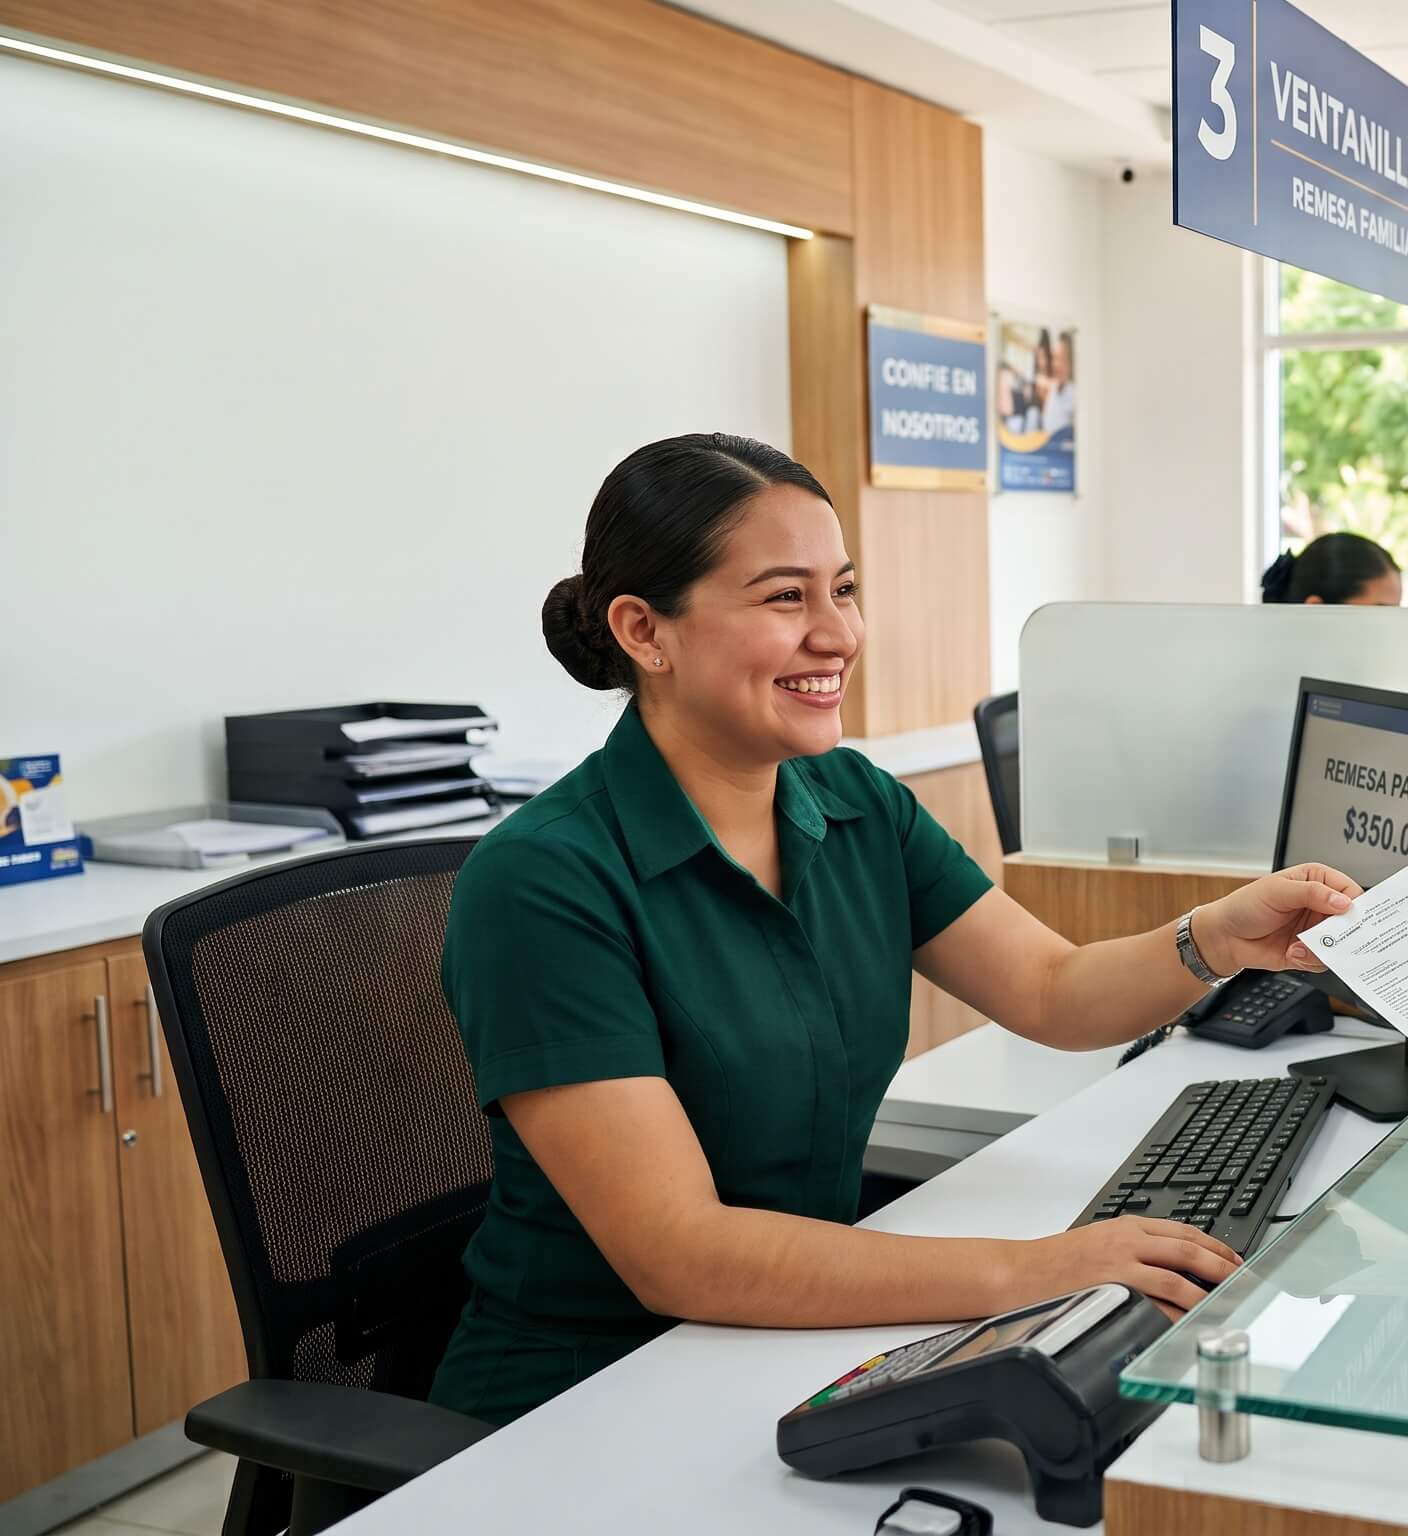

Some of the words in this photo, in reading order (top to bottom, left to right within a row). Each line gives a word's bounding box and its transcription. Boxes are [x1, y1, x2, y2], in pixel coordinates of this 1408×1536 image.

[1198, 24, 1237, 161] 3
[1292, 176, 1358, 235] REMESA
[881, 356, 950, 394] CONFIE
[951, 367, 977, 397] EN
[881, 409, 981, 445] NOSOTROS
[1324, 757, 1387, 795] REMESA
